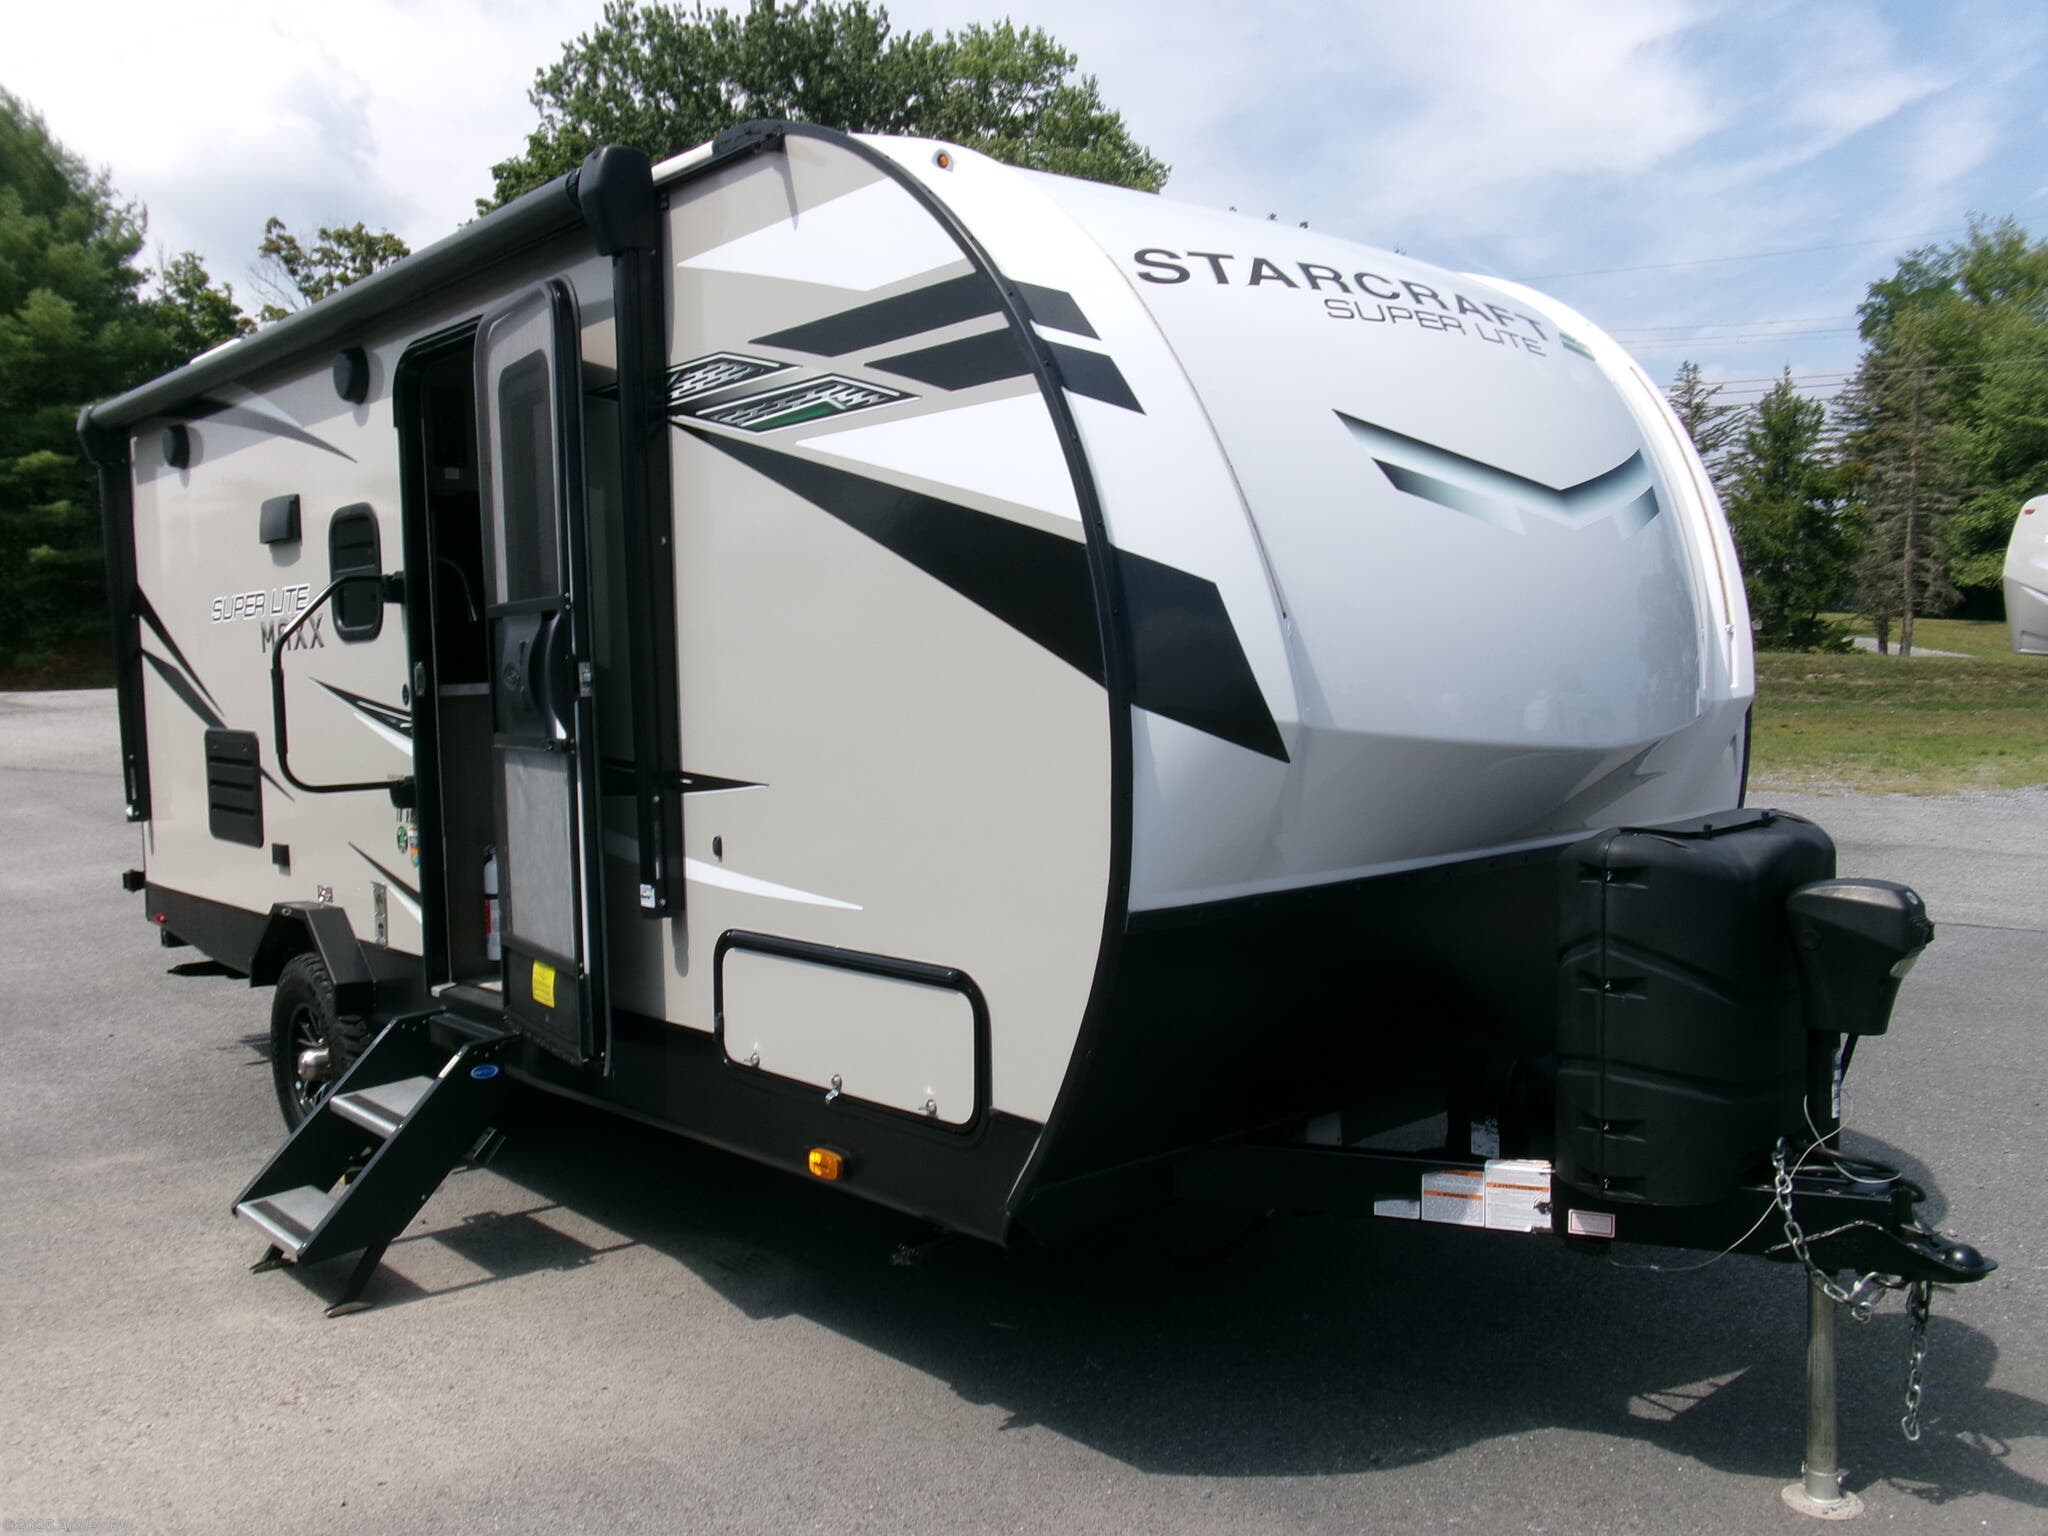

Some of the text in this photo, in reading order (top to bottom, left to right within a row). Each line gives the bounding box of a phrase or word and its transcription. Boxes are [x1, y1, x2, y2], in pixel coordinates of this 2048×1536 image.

[1134, 248, 1549, 341] STARCRAFT
[1324, 298, 1547, 357] SUPER LITE
[211, 583, 310, 622] SUPER LITE
